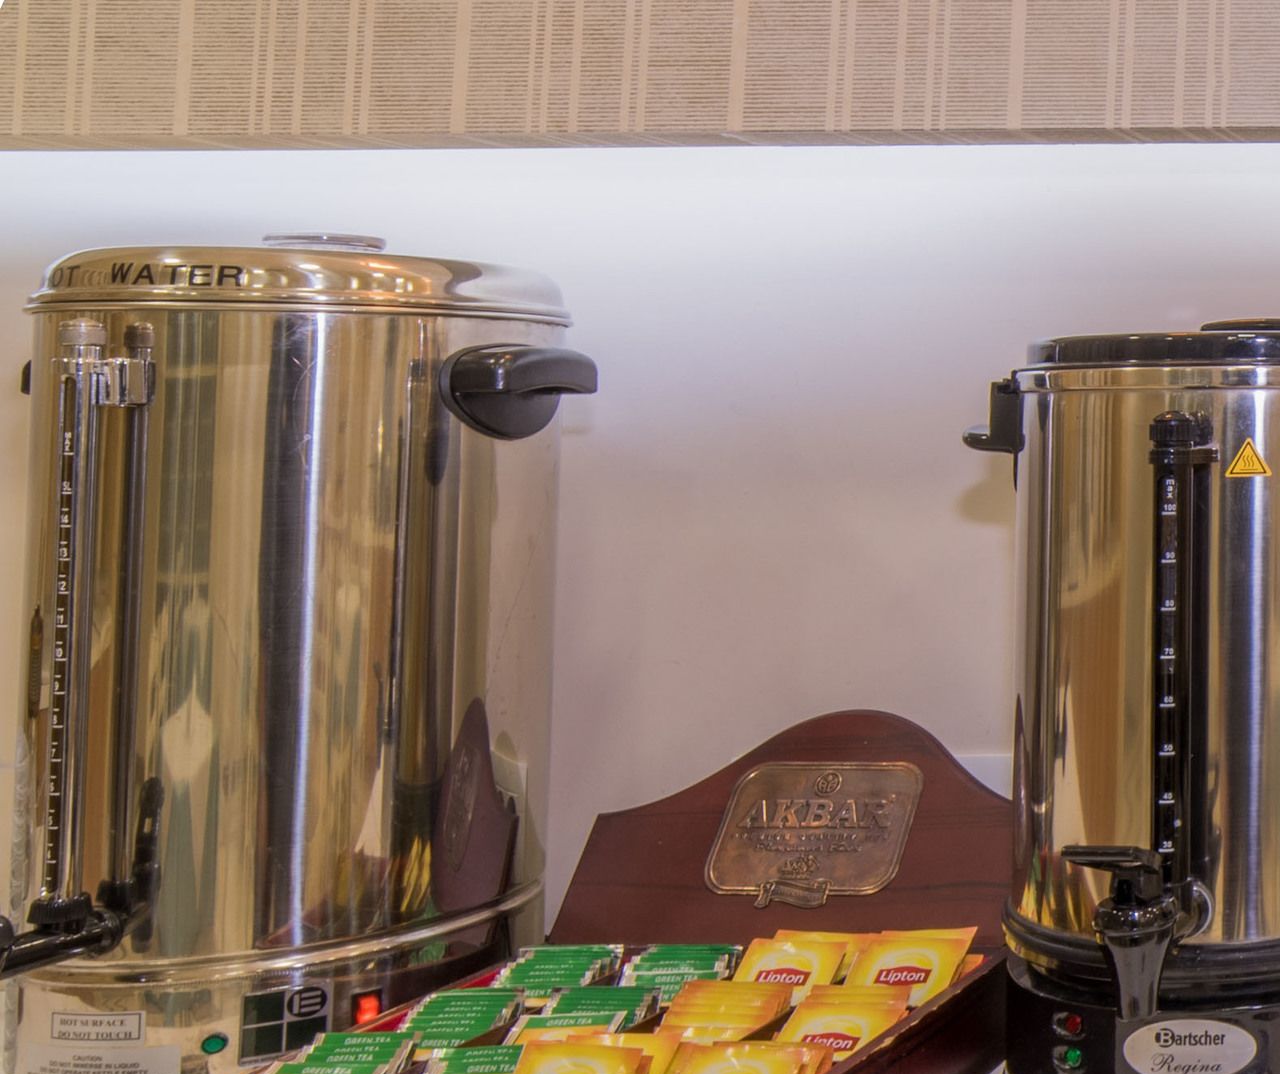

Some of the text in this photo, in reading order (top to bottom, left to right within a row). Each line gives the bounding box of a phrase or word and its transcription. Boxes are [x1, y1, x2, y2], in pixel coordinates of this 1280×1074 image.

[110, 262, 245, 288] WATER
[1163, 503, 1177, 511] 100
[737, 799, 890, 829] AKBAR
[880, 969, 925, 982] Lipton
[60, 1018, 126, 1027] HOT SURFACE
[546, 1017, 594, 1026] GREEN TEA
[57, 1030, 132, 1040] DO NOT TOUCH
[1155, 1027, 1226, 1048] Bartscher
[302, 1067, 333, 1074] GREEN
[467, 1064, 497, 1073] GREEN
